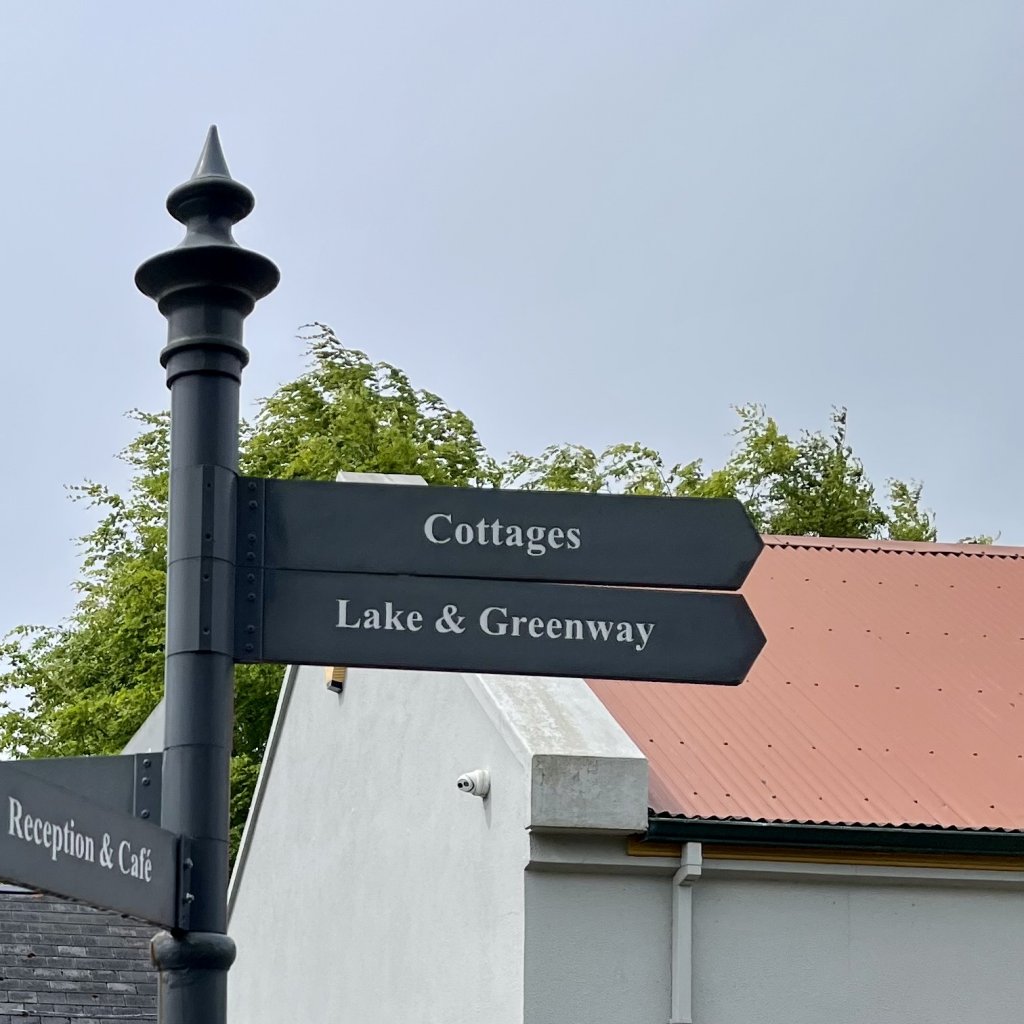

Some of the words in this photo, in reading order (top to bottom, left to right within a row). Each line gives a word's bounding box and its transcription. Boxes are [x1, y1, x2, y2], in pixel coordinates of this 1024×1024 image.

[423, 513, 582, 557] Cottages
[335, 599, 423, 632] Lake
[435, 604, 466, 634] &
[479, 606, 655, 652] Greenway
[8, 796, 95, 863] Reception
[99, 832, 115, 870] &
[118, 840, 153, 883] Café
